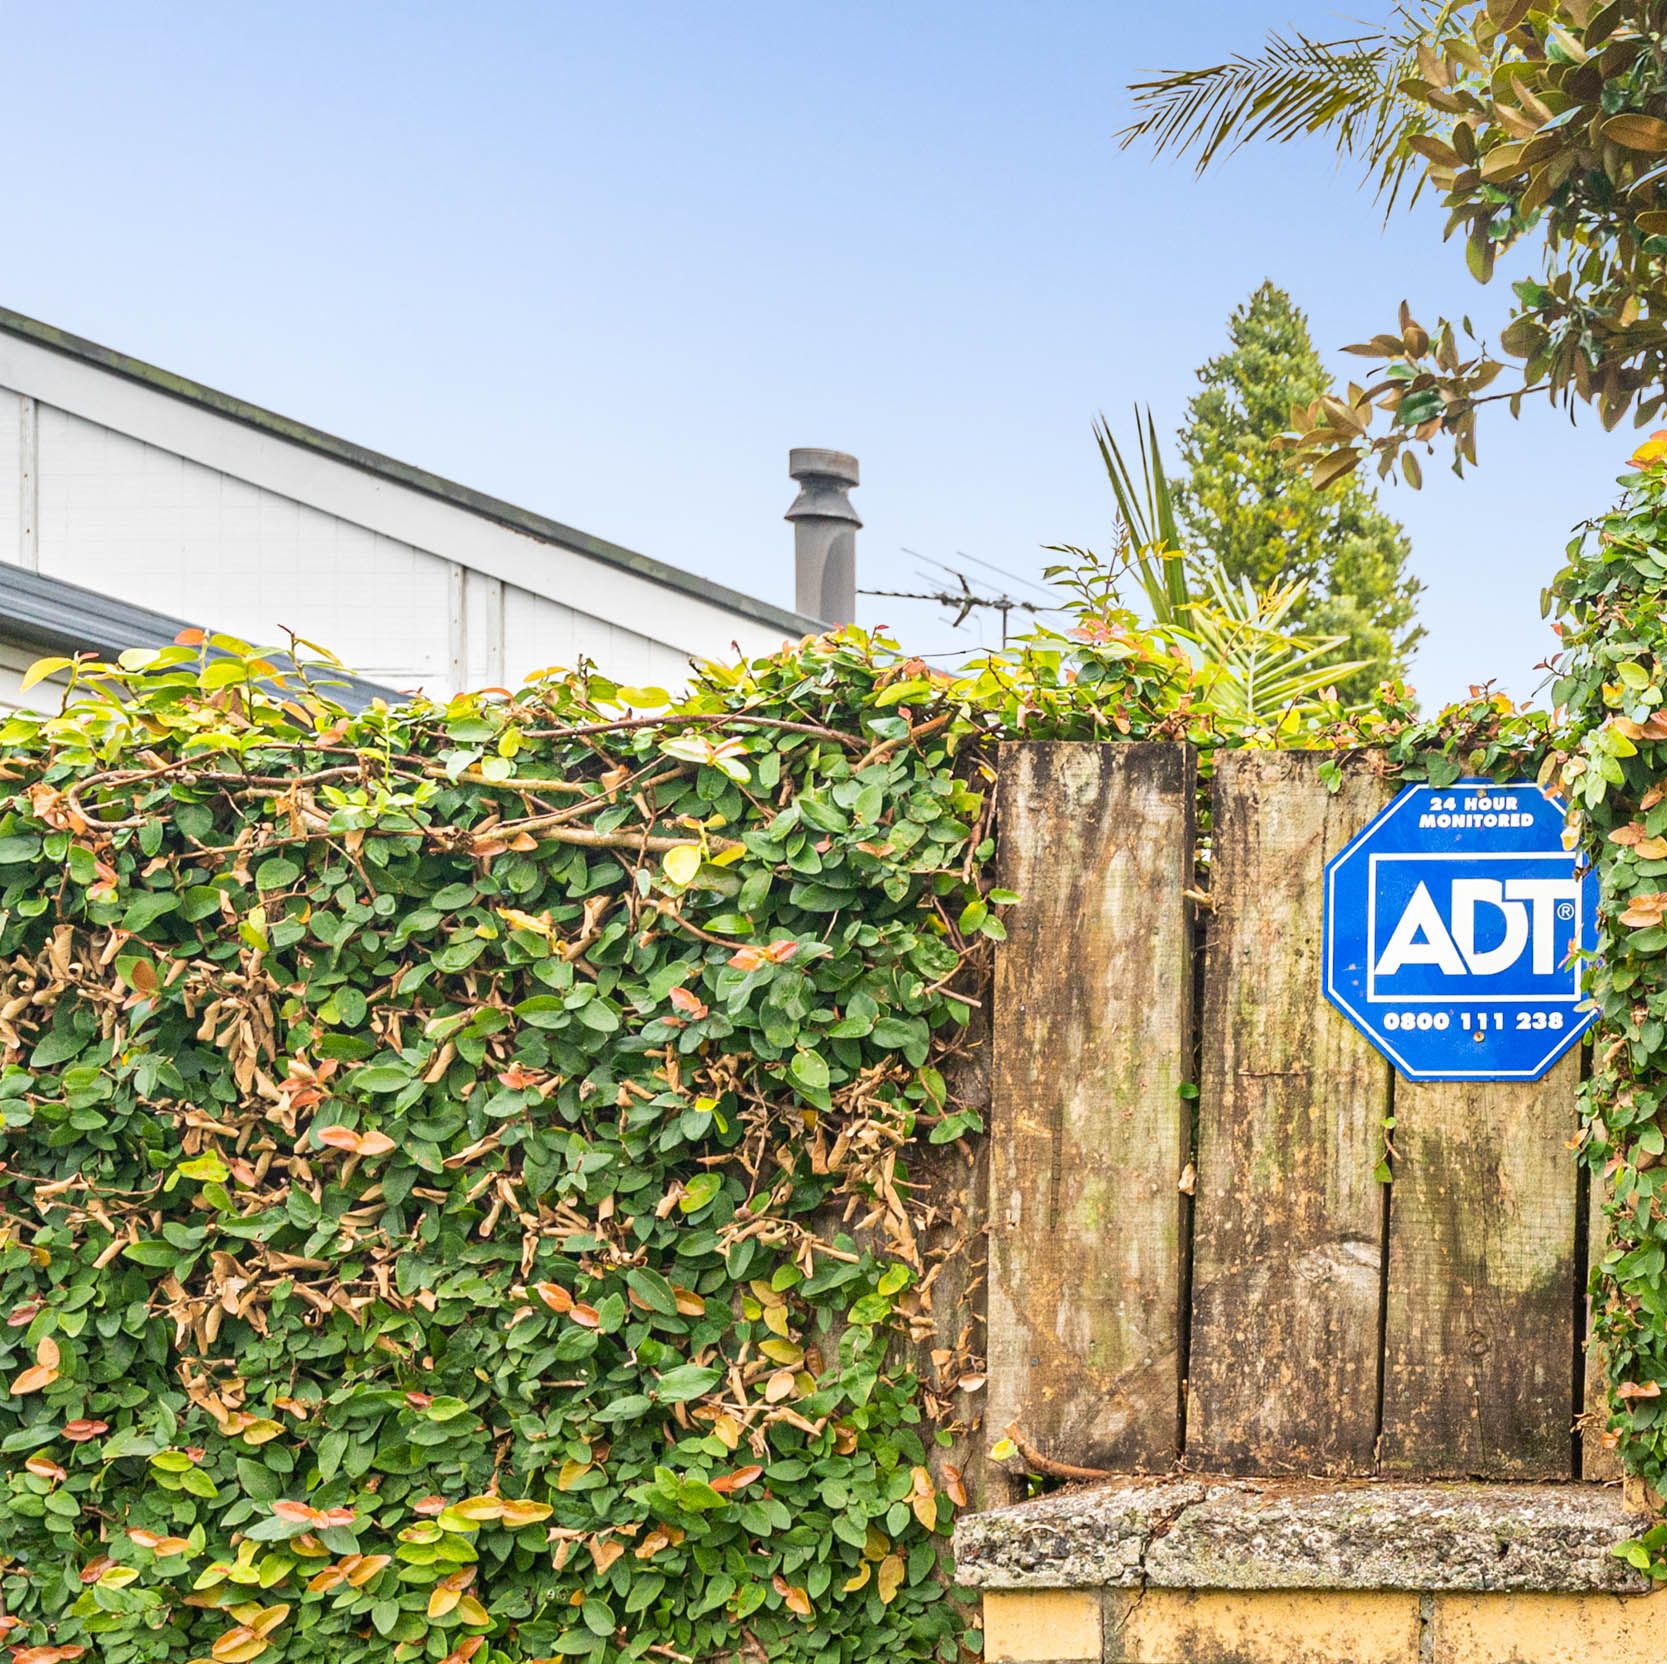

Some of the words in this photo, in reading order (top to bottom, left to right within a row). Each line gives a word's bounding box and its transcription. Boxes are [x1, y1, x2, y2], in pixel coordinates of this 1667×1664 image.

[1429, 797, 1457, 811] 24
[1464, 797, 1518, 811] HOUR
[1418, 813, 1534, 828] MONITORED
[1383, 1012, 1450, 1030] 0800
[1460, 1012, 1504, 1030] 111
[1515, 1012, 1564, 1030] 238
